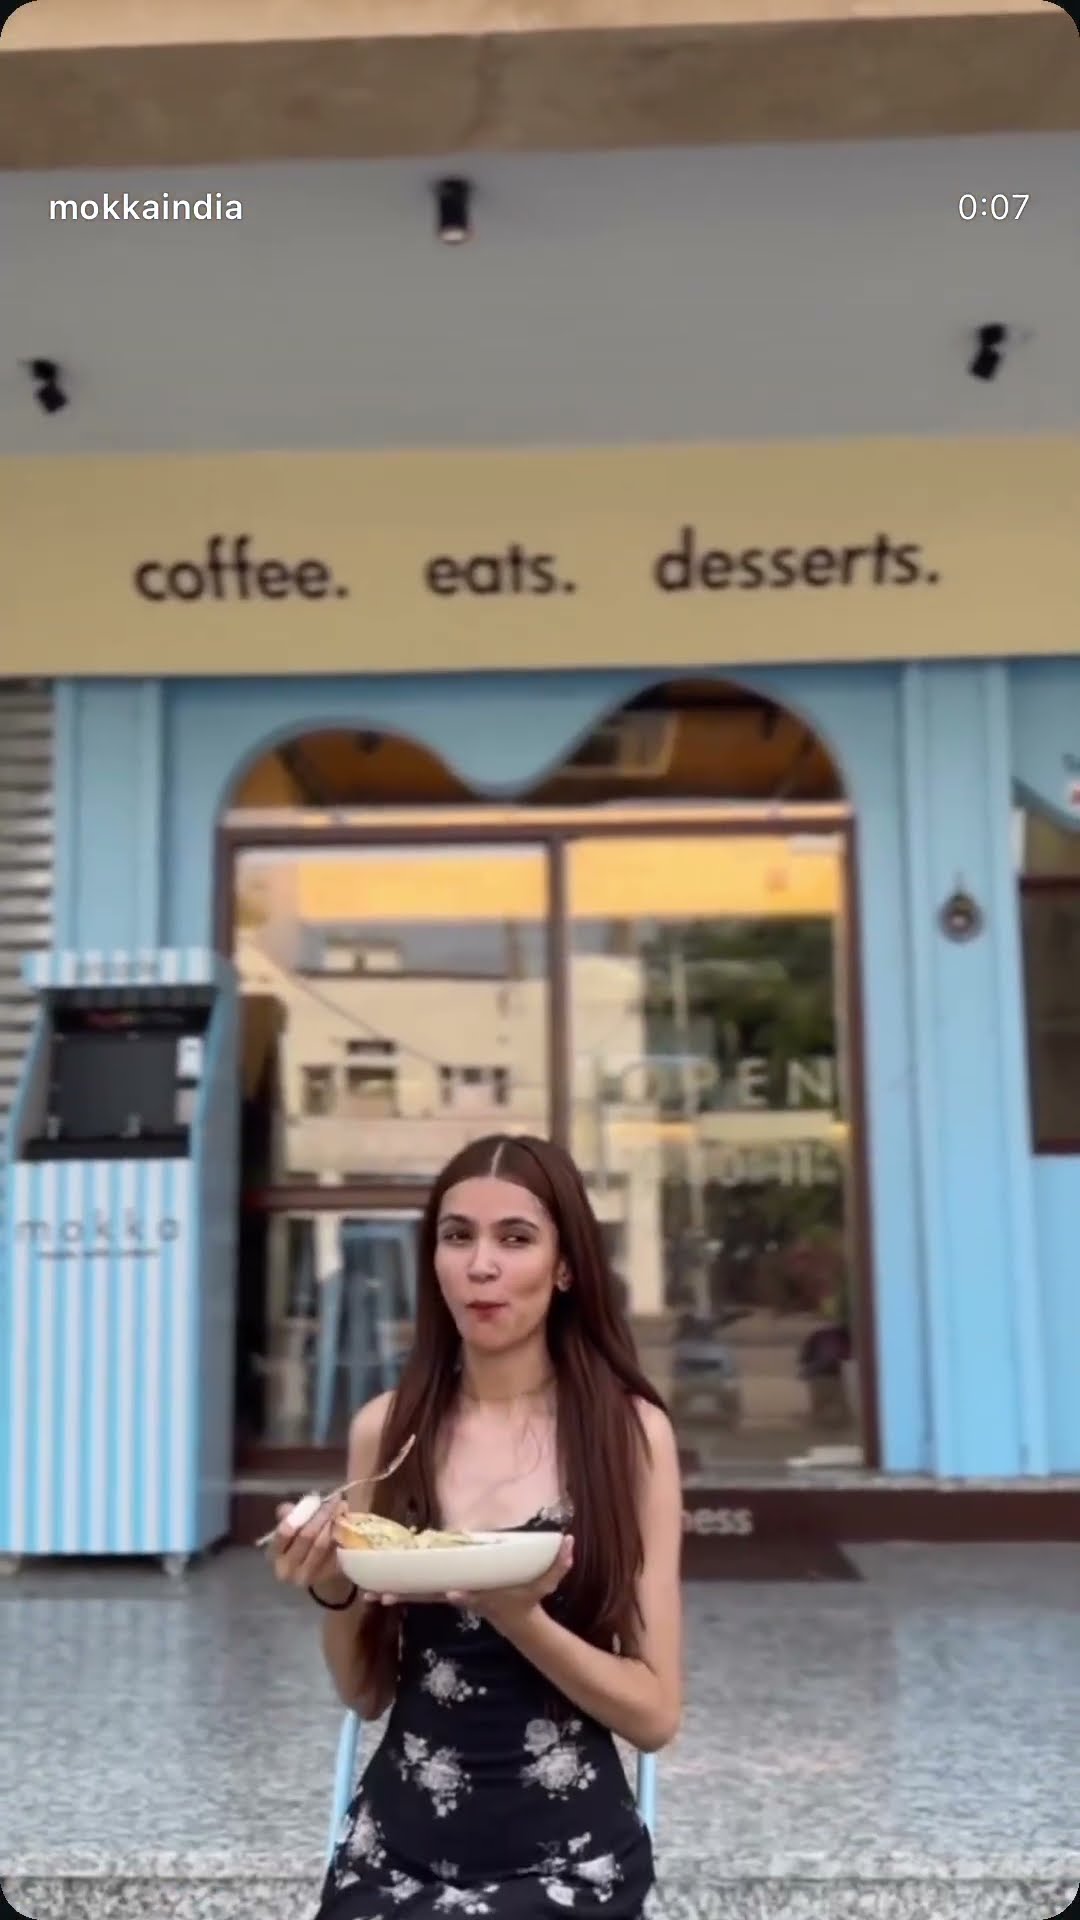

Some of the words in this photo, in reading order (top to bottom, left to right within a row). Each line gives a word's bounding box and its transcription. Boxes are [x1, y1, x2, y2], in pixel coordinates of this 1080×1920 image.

[134, 534, 349, 602] coffee.
[424, 544, 577, 597] eats.
[653, 526, 940, 593] desserts.
[620, 1056, 834, 1108] OPEN
